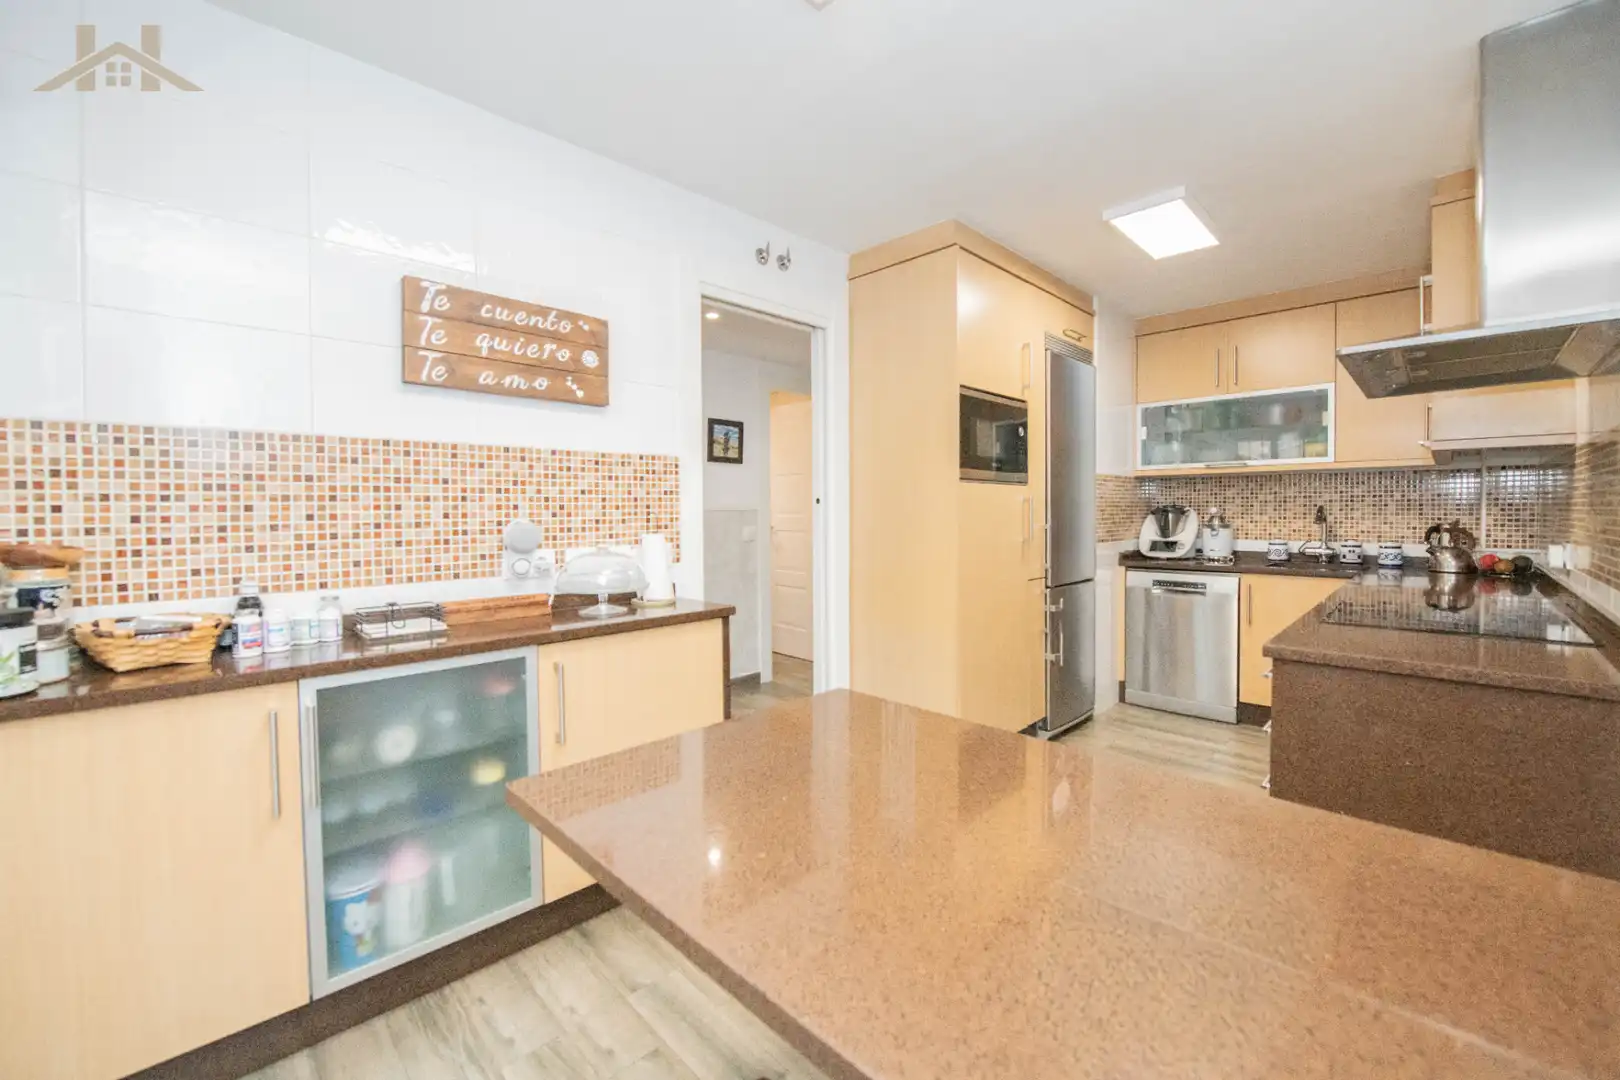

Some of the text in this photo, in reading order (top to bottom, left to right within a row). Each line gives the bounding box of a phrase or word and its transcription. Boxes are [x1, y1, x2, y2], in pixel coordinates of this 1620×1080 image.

[420, 280, 573, 333] Te cuento
[418, 316, 570, 362] Te quiero
[418, 351, 551, 390] Te amo
